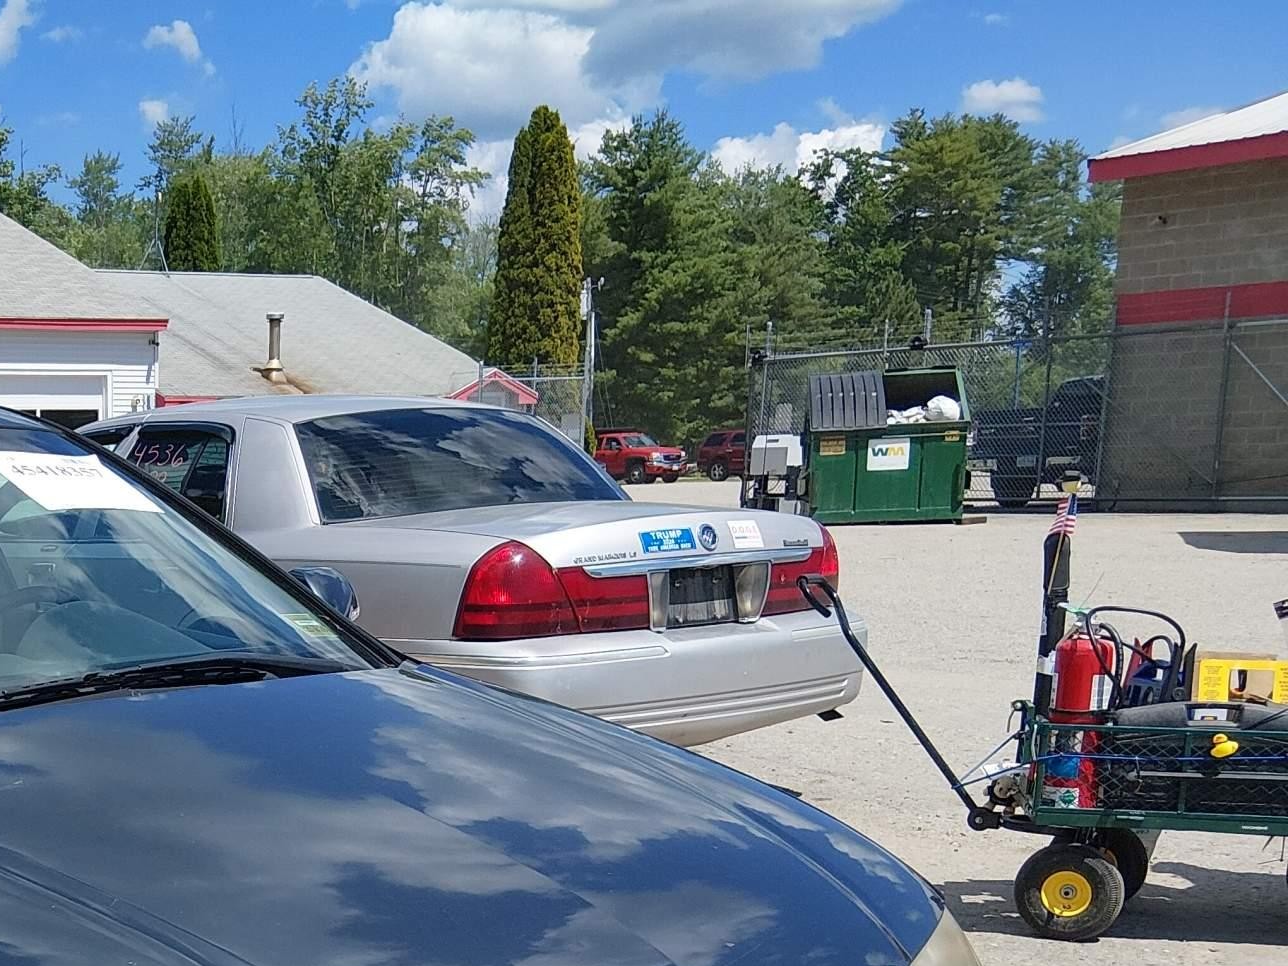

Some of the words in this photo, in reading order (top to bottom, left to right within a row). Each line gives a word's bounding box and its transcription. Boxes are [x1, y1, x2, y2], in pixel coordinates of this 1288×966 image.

[134, 442, 186, 467] 4536
[872, 447, 904, 457] WM
[11, 464, 104, 478] 45418357
[649, 530, 682, 540] TRUMP
